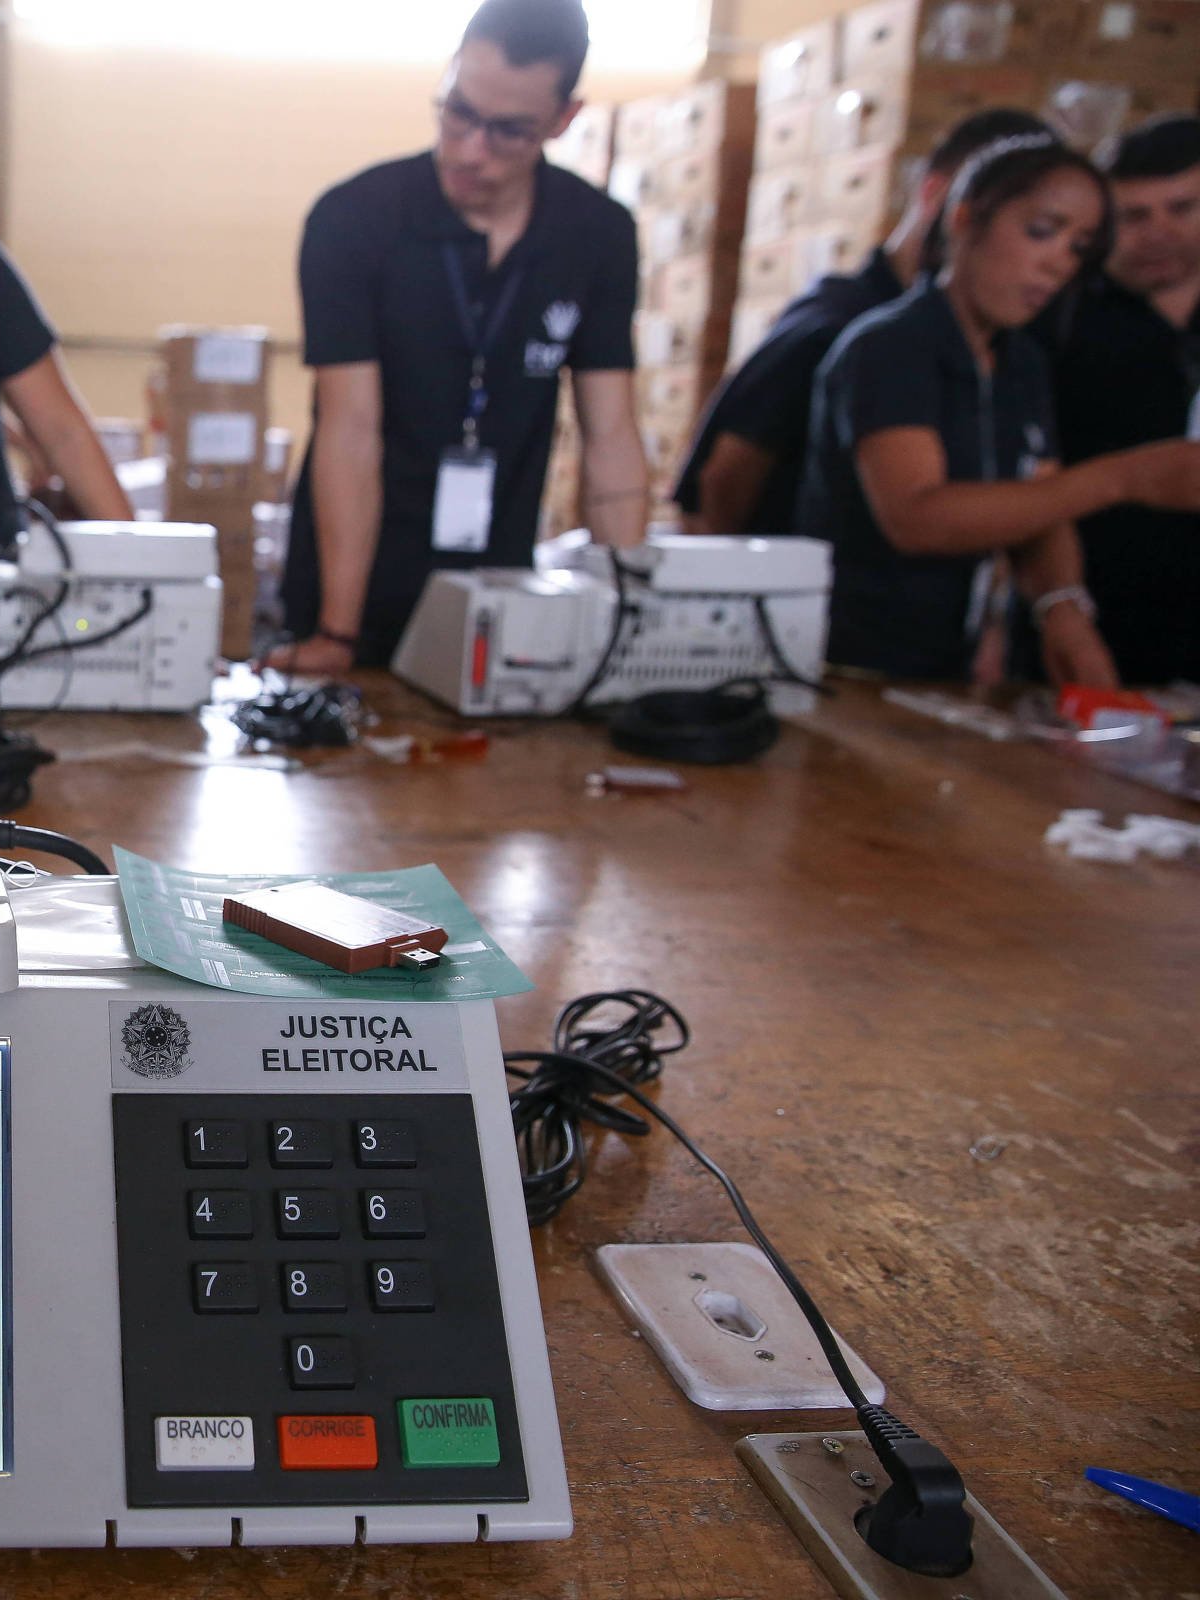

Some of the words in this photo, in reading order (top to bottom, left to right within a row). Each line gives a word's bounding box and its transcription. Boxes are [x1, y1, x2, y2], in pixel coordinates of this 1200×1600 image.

[280, 1015, 412, 1044] JUSTIÇA
[261, 1048, 438, 1072] ELEITORAL
[192, 1126, 206, 1151] 1
[276, 1126, 295, 1151] 2
[360, 1126, 377, 1151] 3
[195, 1196, 213, 1221] 4
[283, 1195, 301, 1221] 5
[369, 1194, 387, 1220] 6
[200, 1271, 218, 1297] 7
[290, 1270, 308, 1296] 8
[376, 1267, 395, 1293] 9
[296, 1345, 314, 1371] 0
[166, 1420, 245, 1439] BRANCO
[287, 1419, 366, 1438] CORRIGE
[411, 1403, 491, 1430] CONFIRMA
